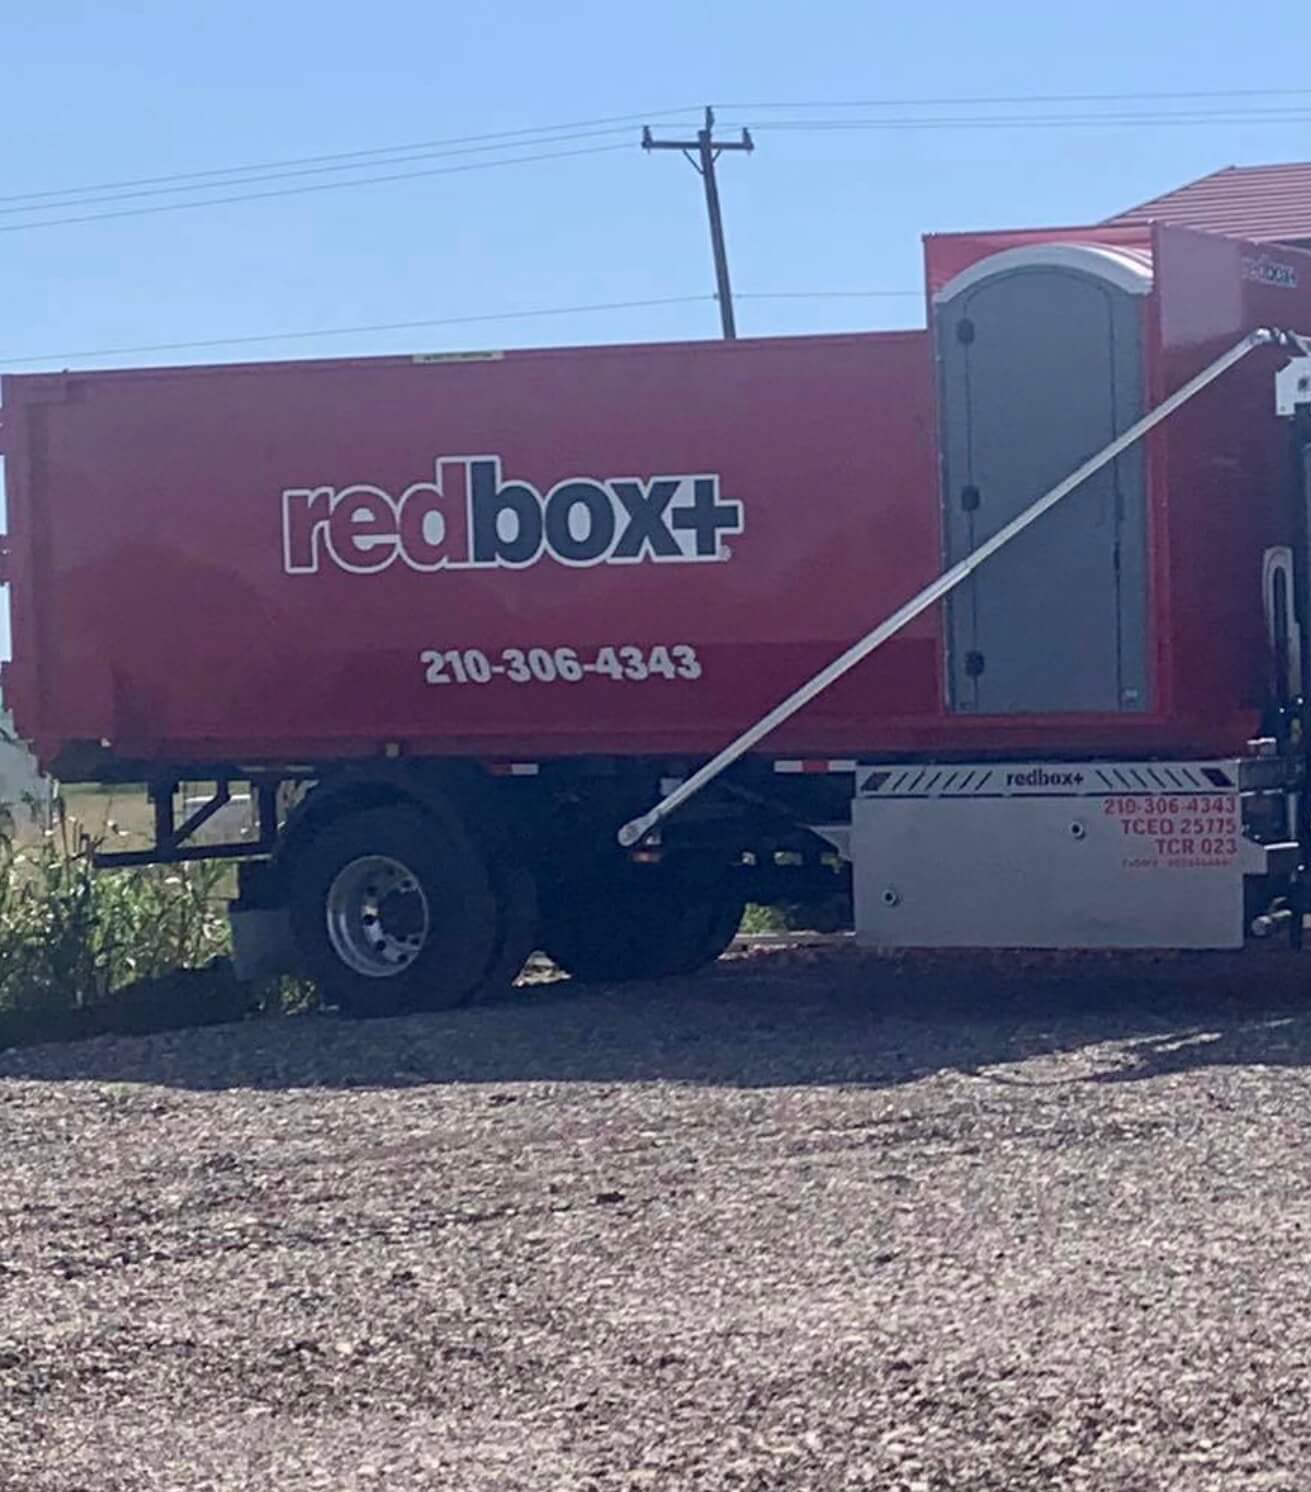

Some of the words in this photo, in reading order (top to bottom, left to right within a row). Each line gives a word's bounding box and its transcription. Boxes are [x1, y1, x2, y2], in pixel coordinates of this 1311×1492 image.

[282, 454, 745, 574] redbox+
[420, 645, 702, 684] 210-306-4343
[1006, 769, 1084, 787] redbox+
[1104, 797, 1237, 815] 210-306-4343
[1181, 819, 1237, 834] 25775
[1154, 838, 1196, 855] TCR
[1201, 838, 1238, 855] 023
